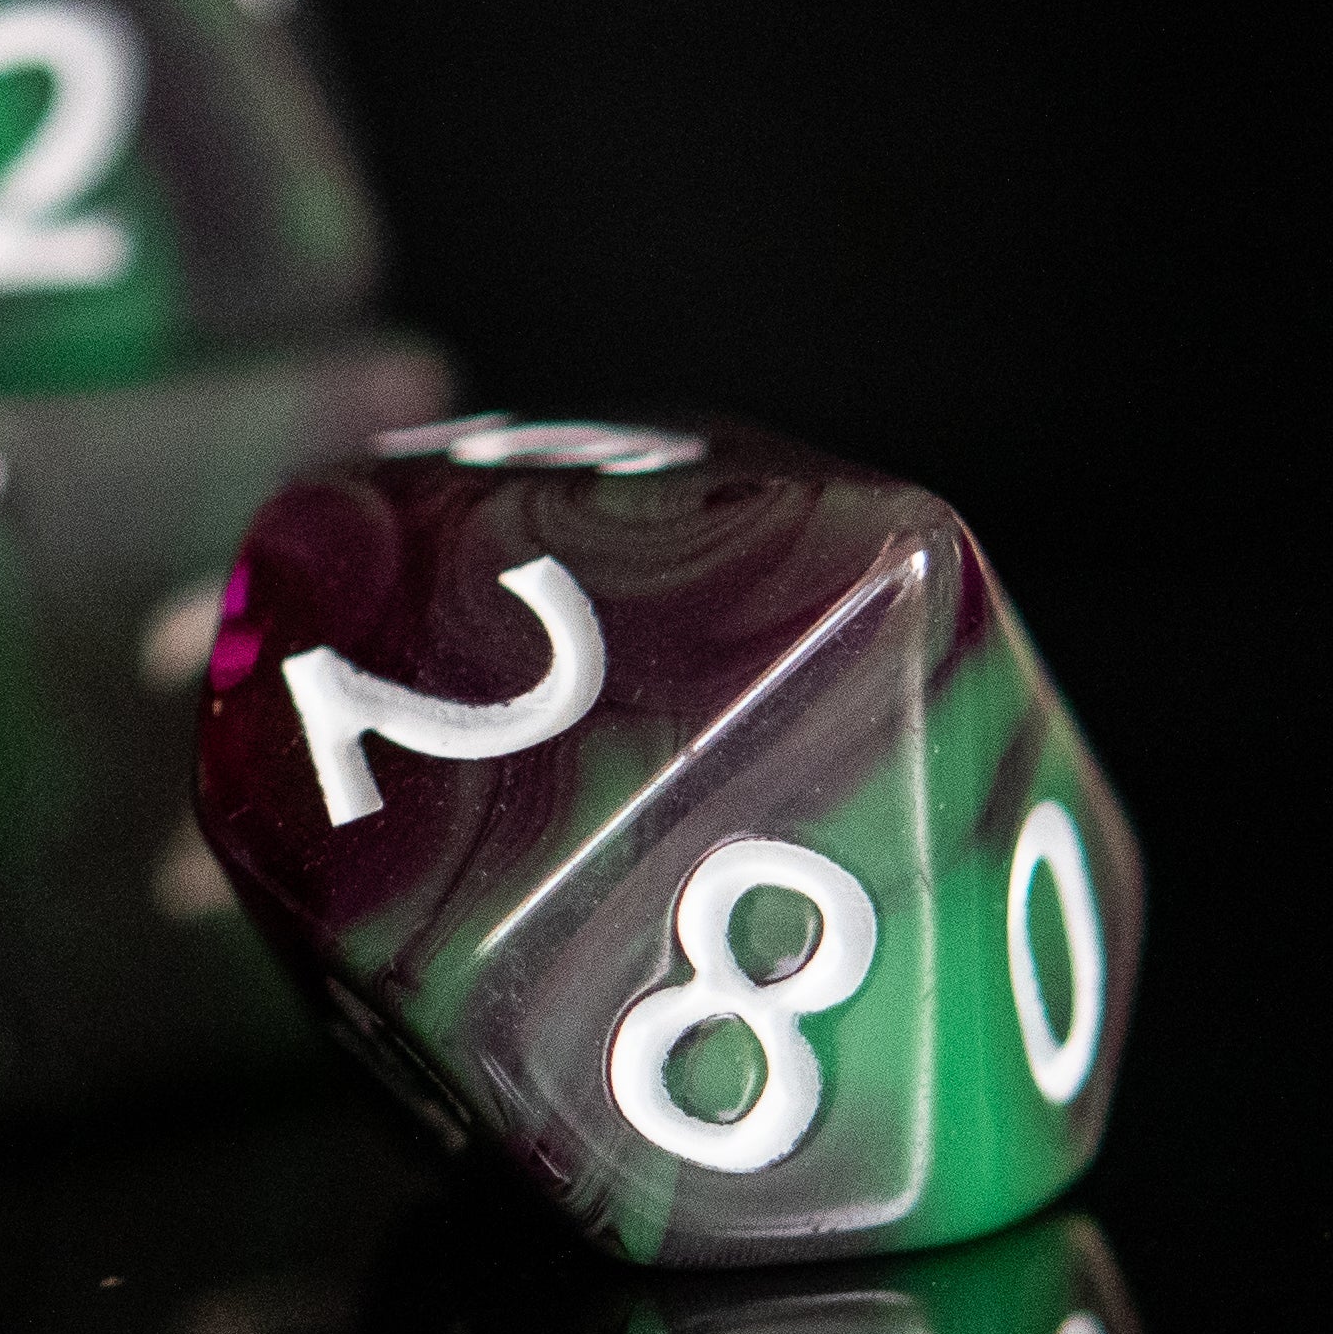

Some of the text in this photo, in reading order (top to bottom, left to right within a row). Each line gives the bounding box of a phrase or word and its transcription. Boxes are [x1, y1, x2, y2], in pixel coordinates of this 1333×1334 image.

[281, 554, 606, 828] 2
[610, 837, 877, 1174] 8
[1005, 799, 1102, 1105] 0
